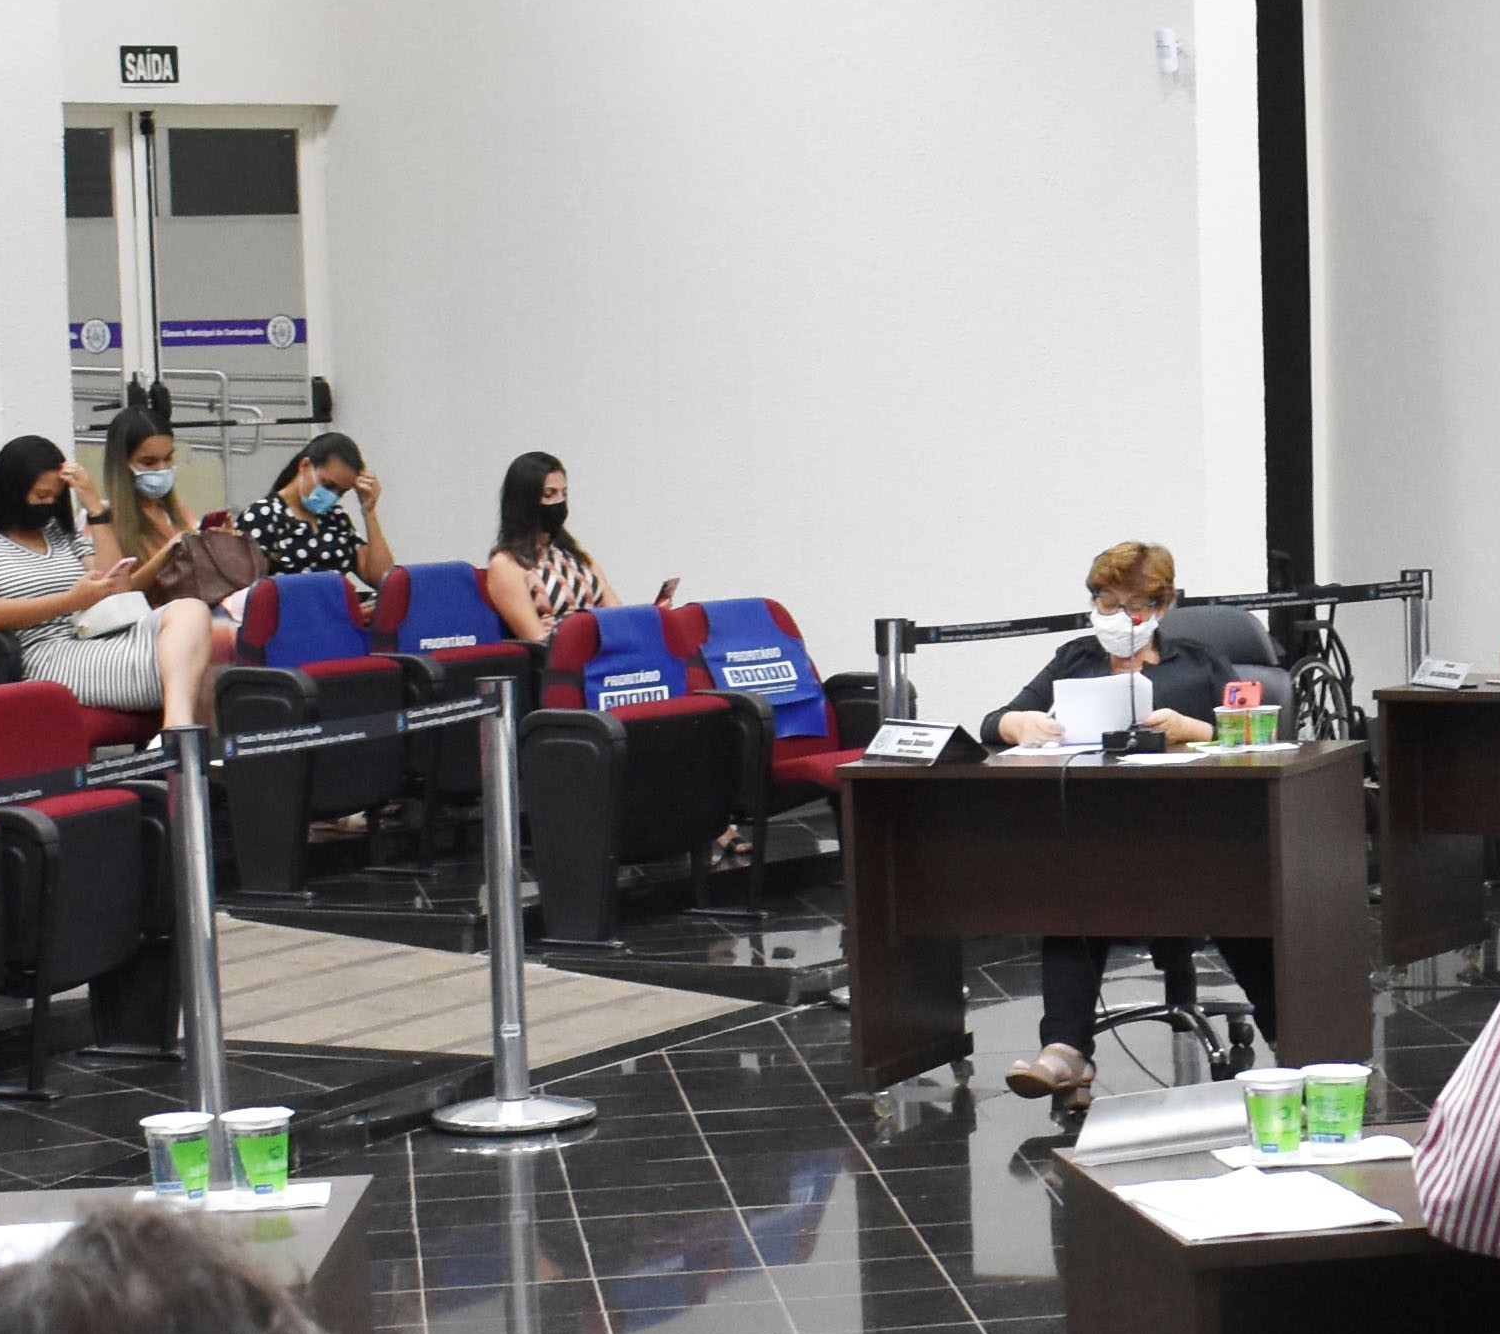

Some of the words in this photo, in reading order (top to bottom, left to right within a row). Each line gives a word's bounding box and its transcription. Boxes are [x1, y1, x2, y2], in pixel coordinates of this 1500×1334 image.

[125, 48, 174, 81] SAÍDA
[725, 646, 782, 663] PRIORITÁRIO
[603, 669, 661, 687] PRIORITÁRIO
